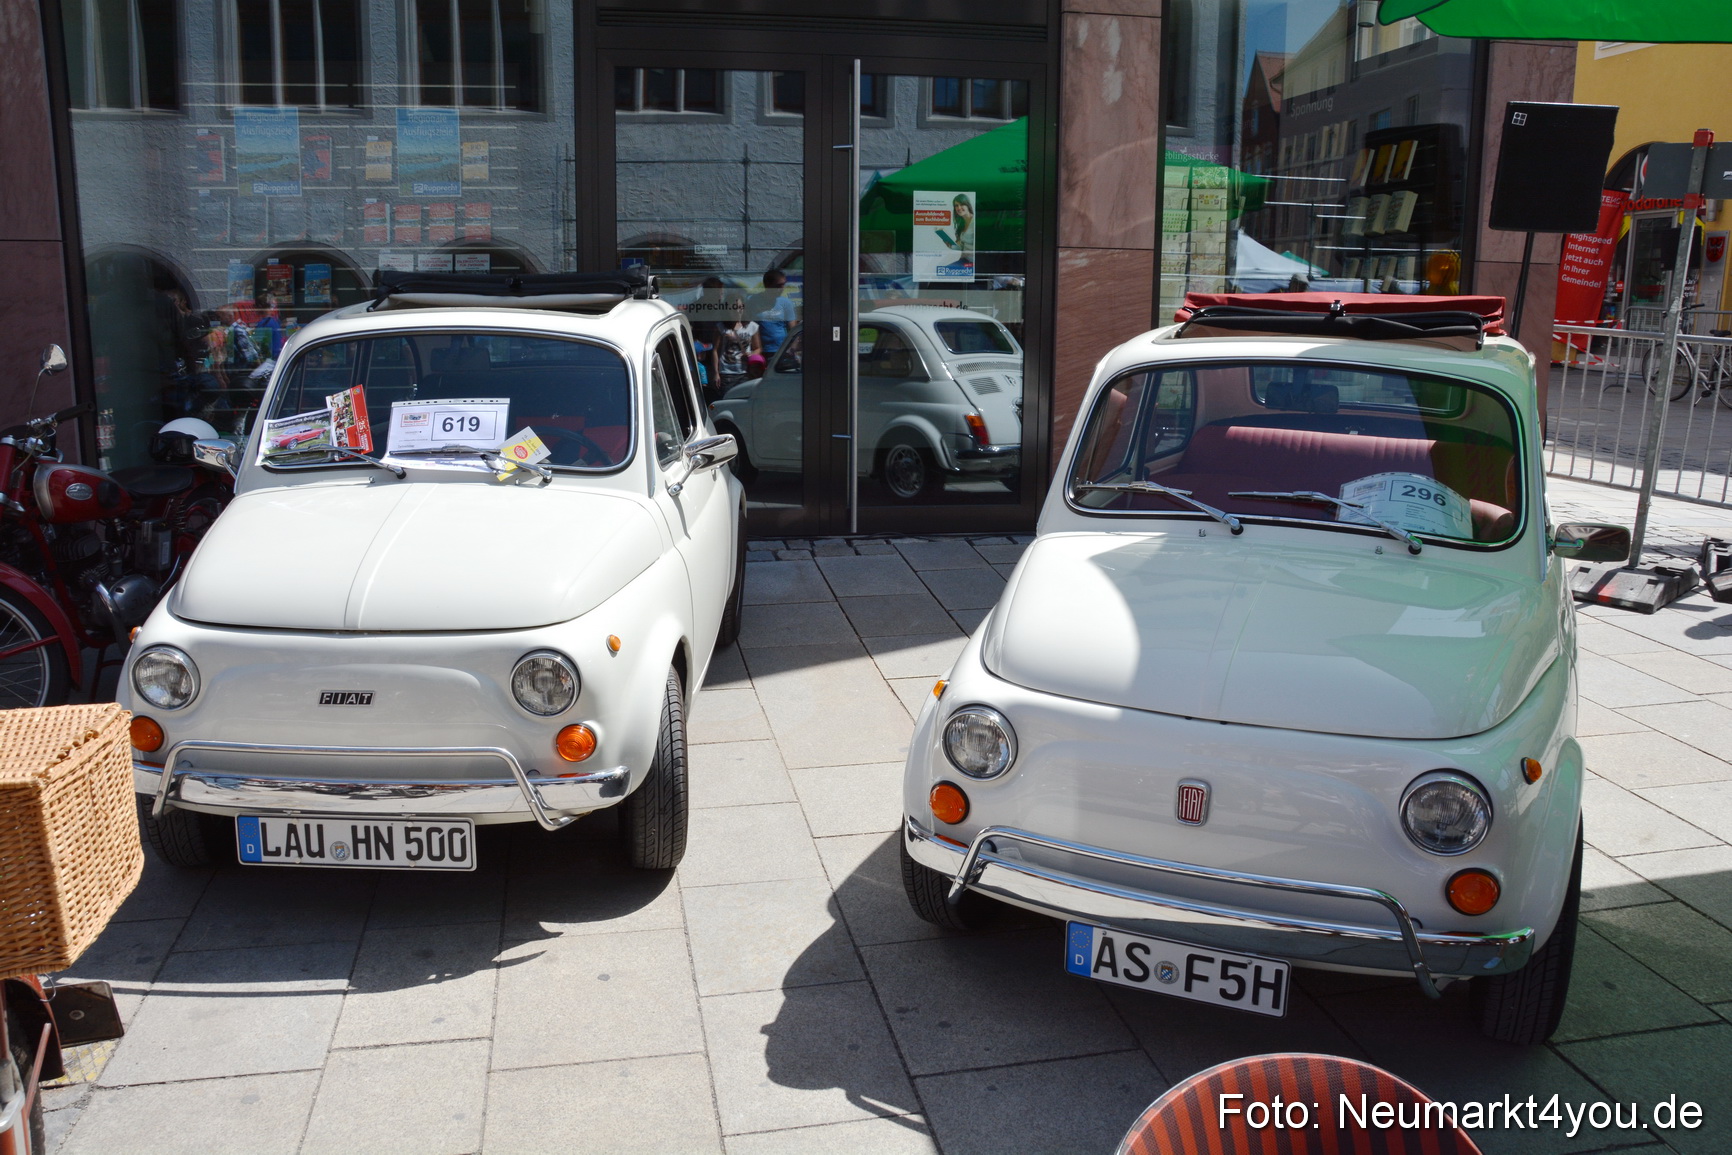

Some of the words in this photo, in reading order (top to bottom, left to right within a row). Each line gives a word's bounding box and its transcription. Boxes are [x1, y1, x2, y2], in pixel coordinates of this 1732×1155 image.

[1290, 96, 1334, 120] Spannung
[408, 113, 447, 125] Regionale
[241, 126, 293, 138] Ausflugsziele
[403, 127, 454, 138] Ausflugsziele
[263, 184, 298, 193] Rupprecht
[423, 184, 458, 193] Rupprecht
[1569, 233, 1613, 245] Highspeed
[1567, 242, 1599, 254] Internet
[1565, 253, 1582, 263] jetzt
[1583, 258, 1604, 266] auch
[945, 266, 973, 275] Rupprecht
[1563, 263, 1570, 271] in
[1571, 267, 1590, 275] Ihrer
[1561, 274, 1602, 288] Gemeinde!
[677, 299, 746, 313] rupprecht.de
[442, 416, 481, 433] 619
[1402, 485, 1447, 506] 296
[321, 692, 373, 705] FIAT
[1181, 787, 1204, 821] FIAT
[261, 821, 326, 859] LAU
[351, 825, 394, 861] HN
[404, 826, 467, 862] 500
[246, 845, 255, 854] D
[1075, 954, 1085, 966] D
[1092, 936, 1151, 983] AS
[1184, 953, 1284, 1010] F5H
